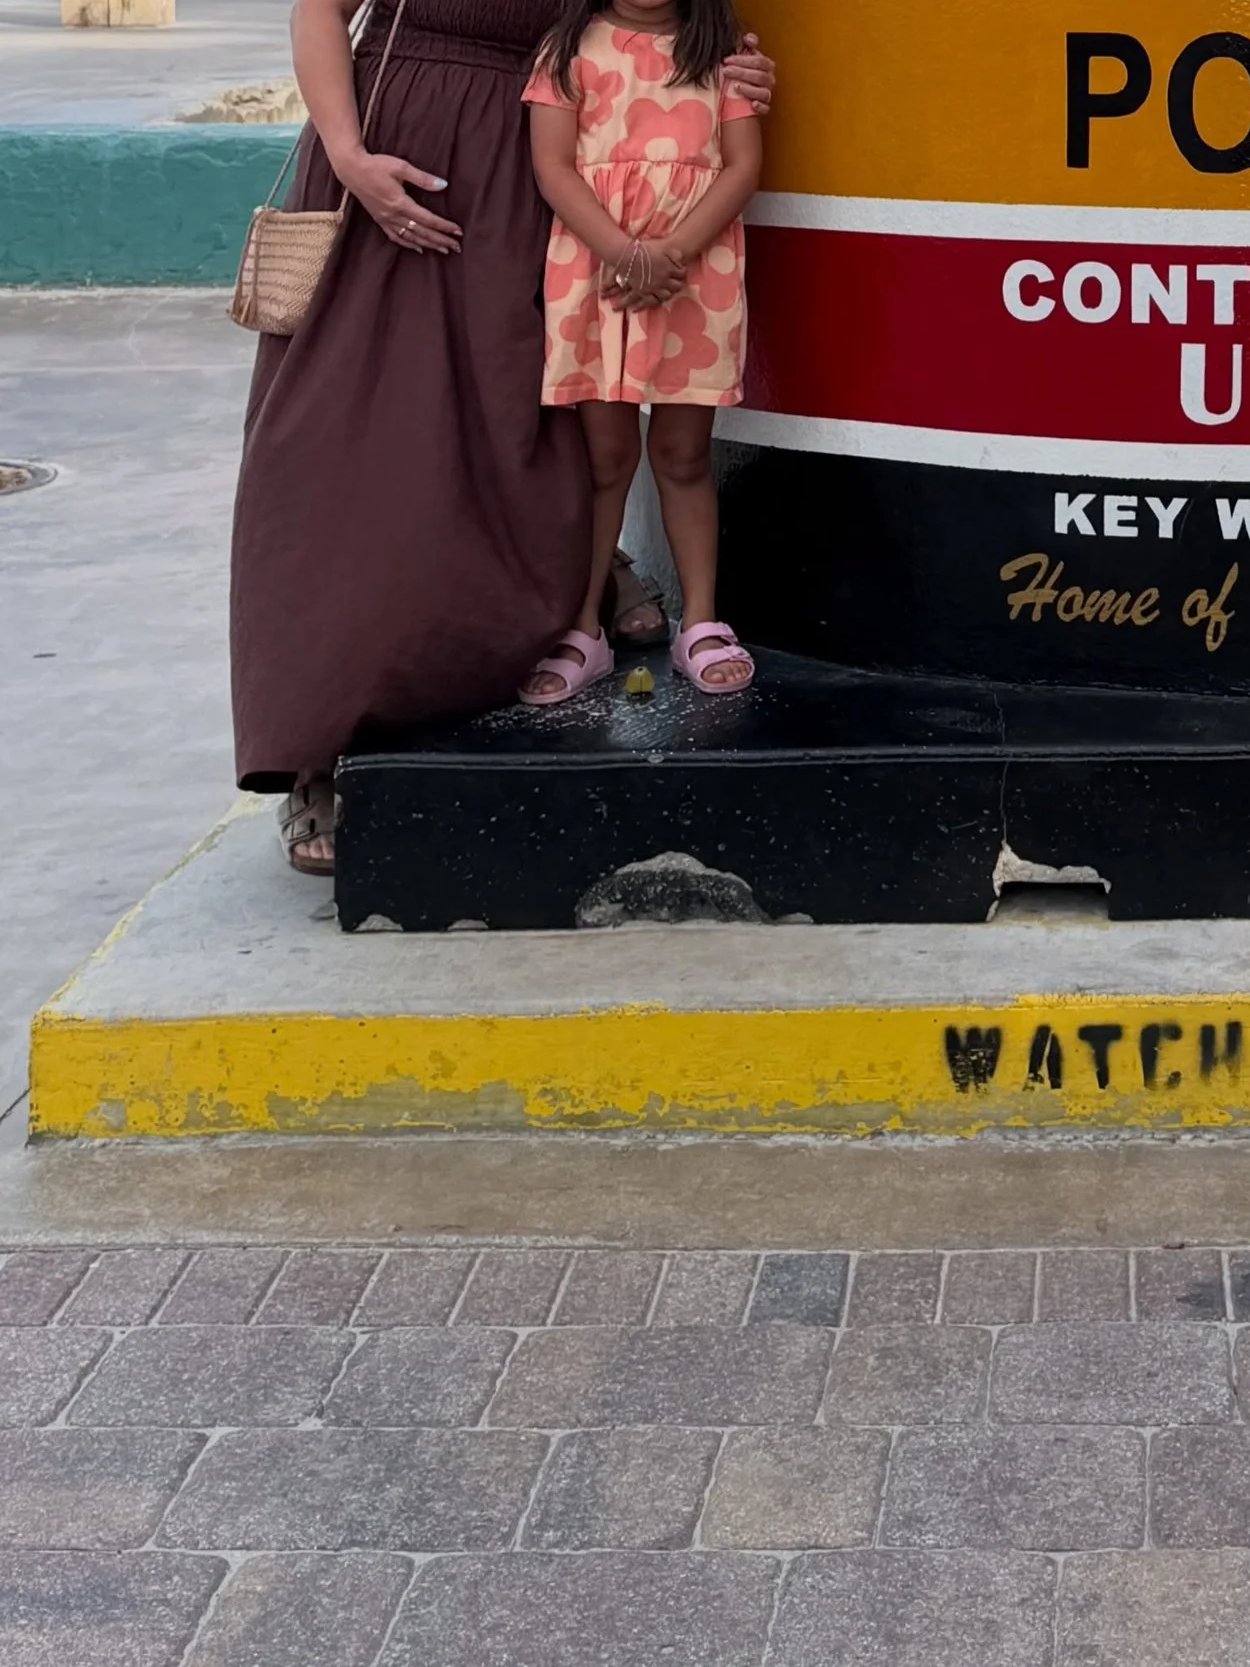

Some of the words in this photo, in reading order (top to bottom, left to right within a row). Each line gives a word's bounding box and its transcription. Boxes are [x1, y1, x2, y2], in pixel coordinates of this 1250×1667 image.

[1053, 492, 1188, 538] KEY
[999, 553, 1160, 626] Home
[1181, 562, 1240, 652] of
[943, 1021, 1244, 1093] WATCH
